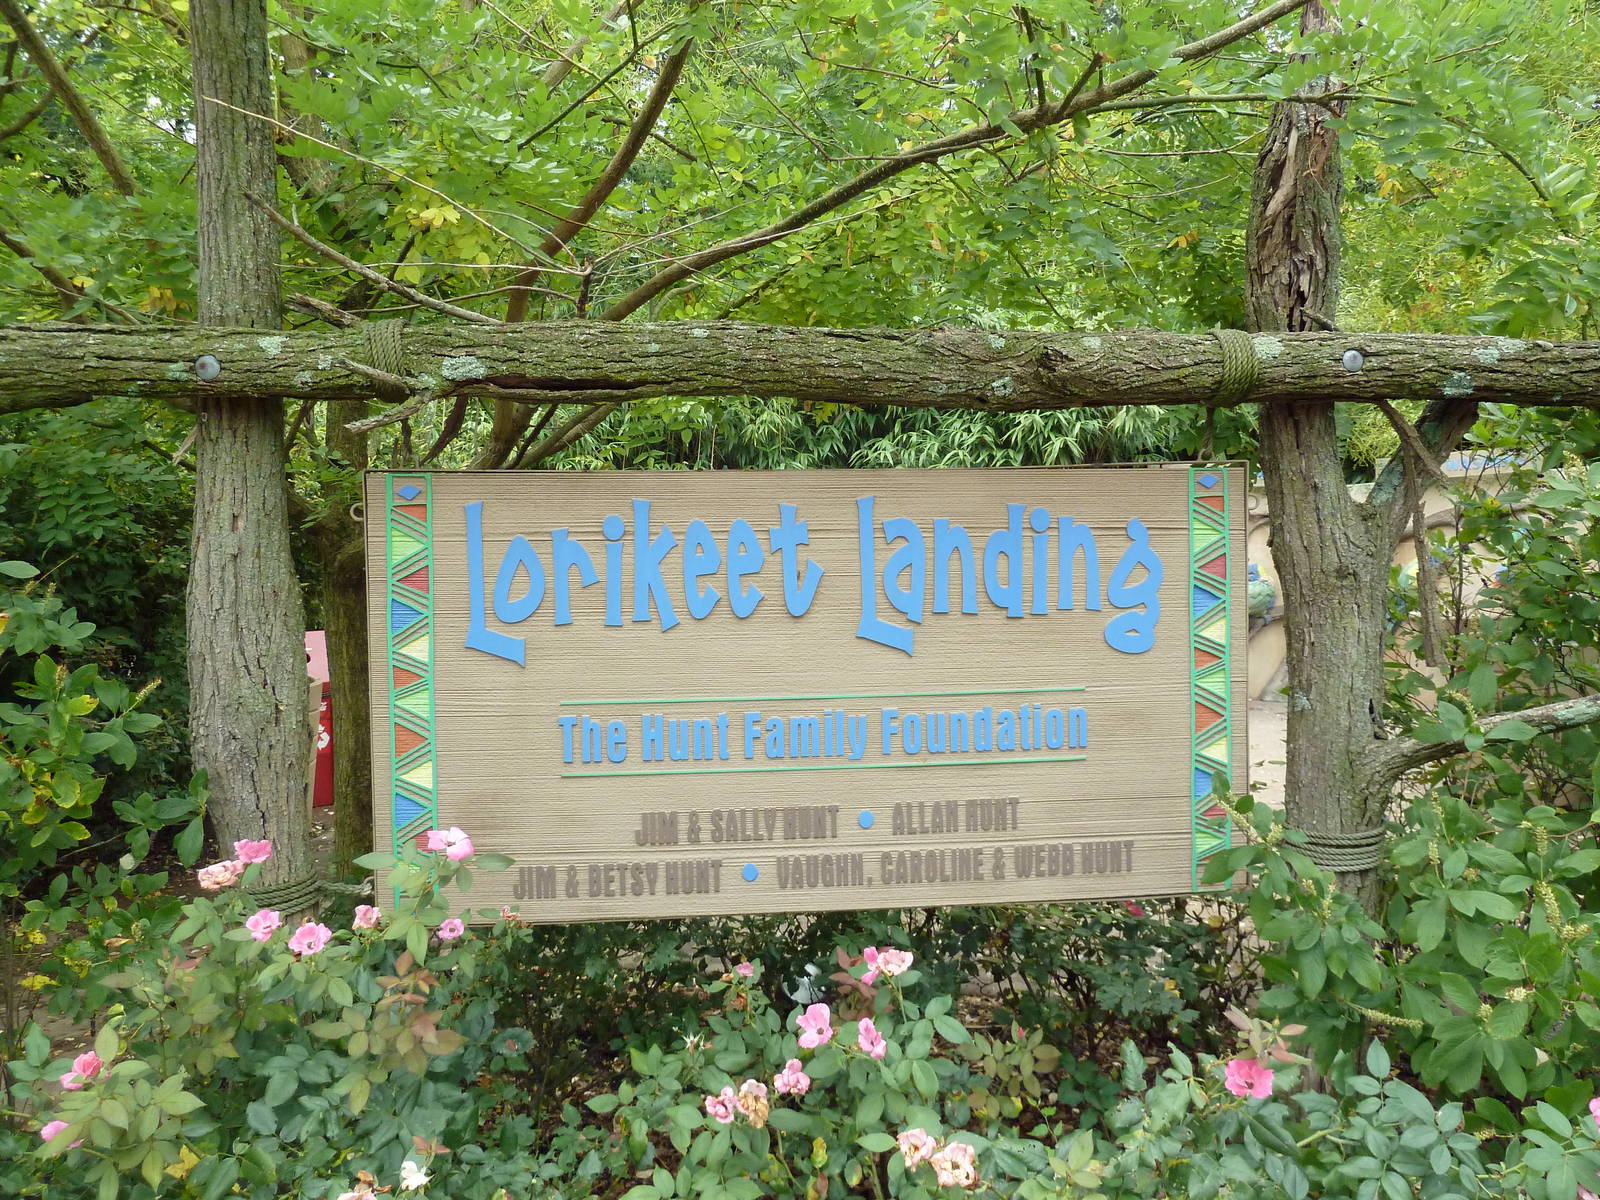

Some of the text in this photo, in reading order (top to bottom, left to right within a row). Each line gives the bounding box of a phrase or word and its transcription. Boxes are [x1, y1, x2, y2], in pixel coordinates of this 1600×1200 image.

[464, 495, 1164, 668] Lorikeet Landing
[558, 704, 1088, 763] The Hunt Family Foundation
[635, 804, 839, 846] JIM & SALLY HUNT
[892, 797, 1020, 836] ALLAN HUNT
[513, 858, 722, 899] JIM & BETSY HUNT
[776, 840, 1135, 889] VAUGHN, CAROLINE & WEBB HUNT
